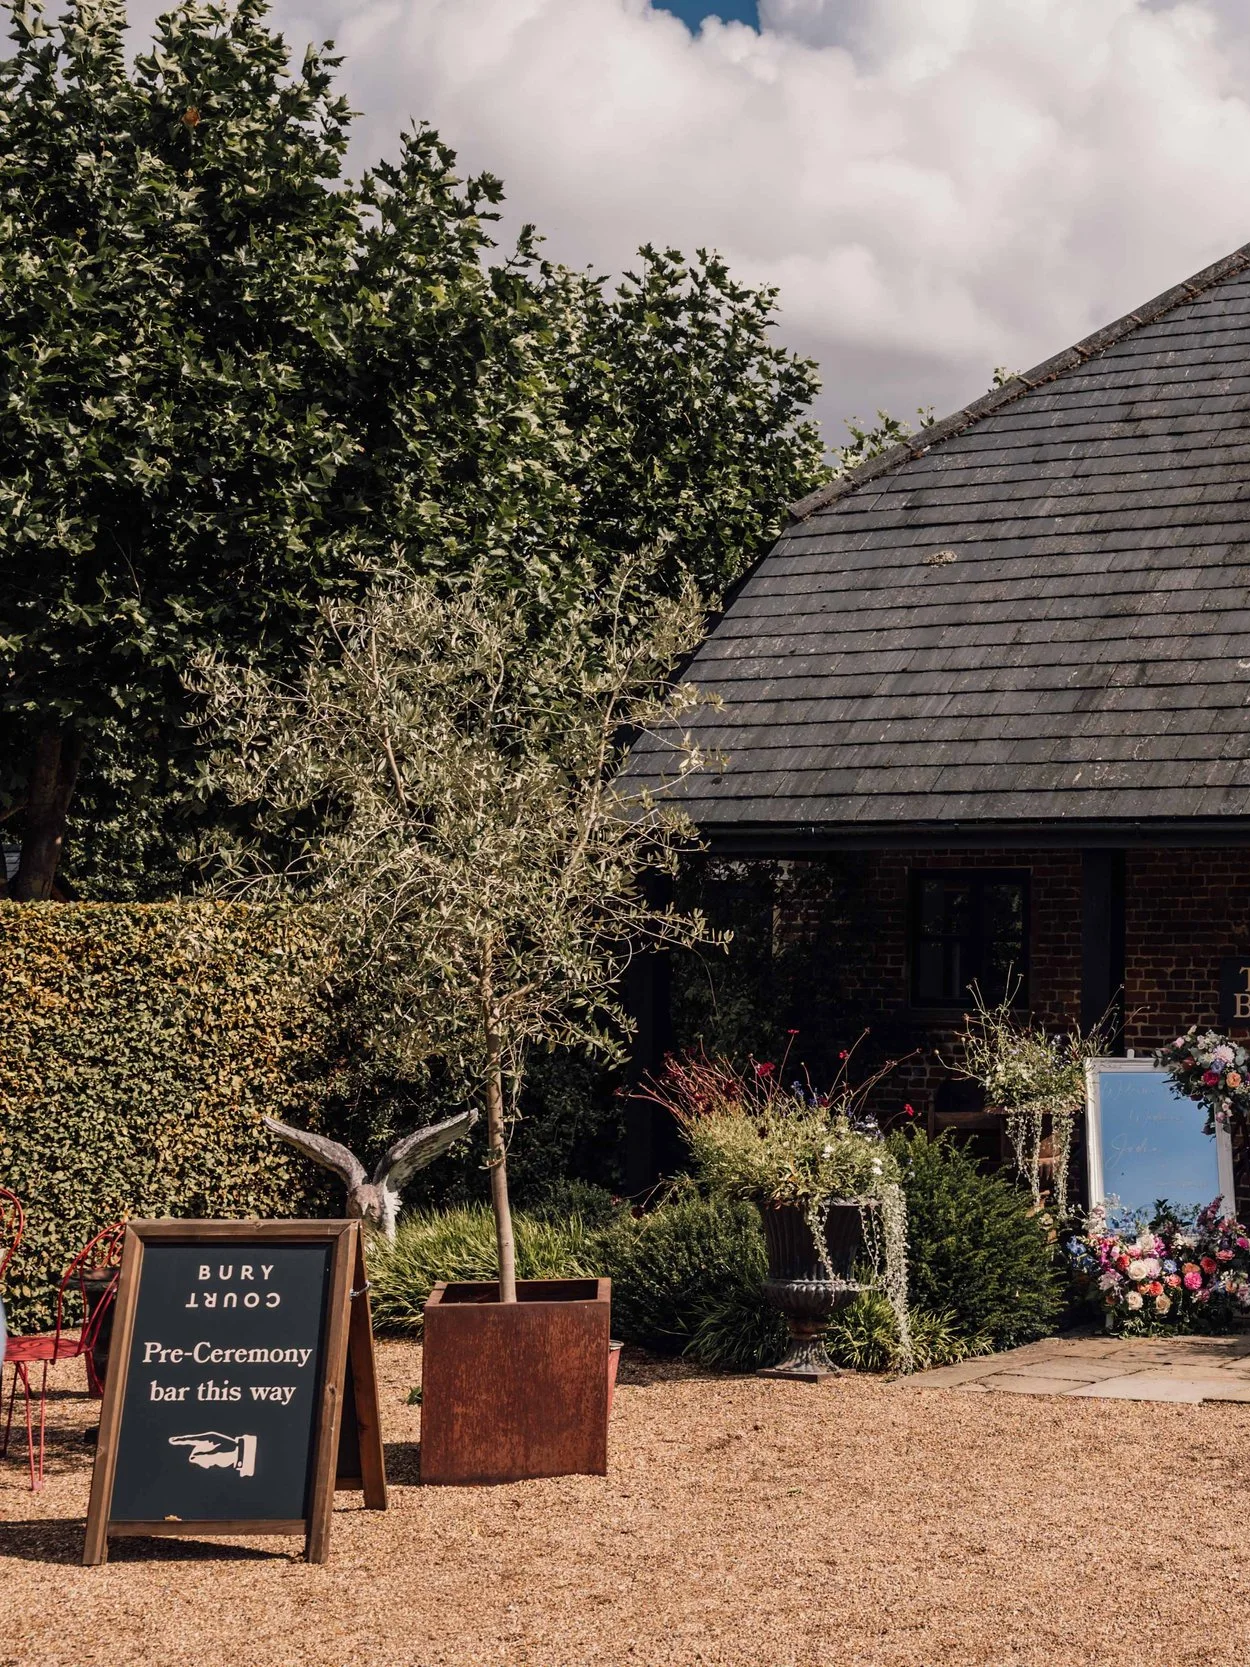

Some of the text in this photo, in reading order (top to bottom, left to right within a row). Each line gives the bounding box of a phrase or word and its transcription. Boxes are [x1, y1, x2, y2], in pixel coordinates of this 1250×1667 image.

[198, 1264, 274, 1281] BURY
[185, 1292, 281, 1308] COURT
[142, 1341, 313, 1368] Pre-Ceremony
[150, 1379, 297, 1406] bar this way
